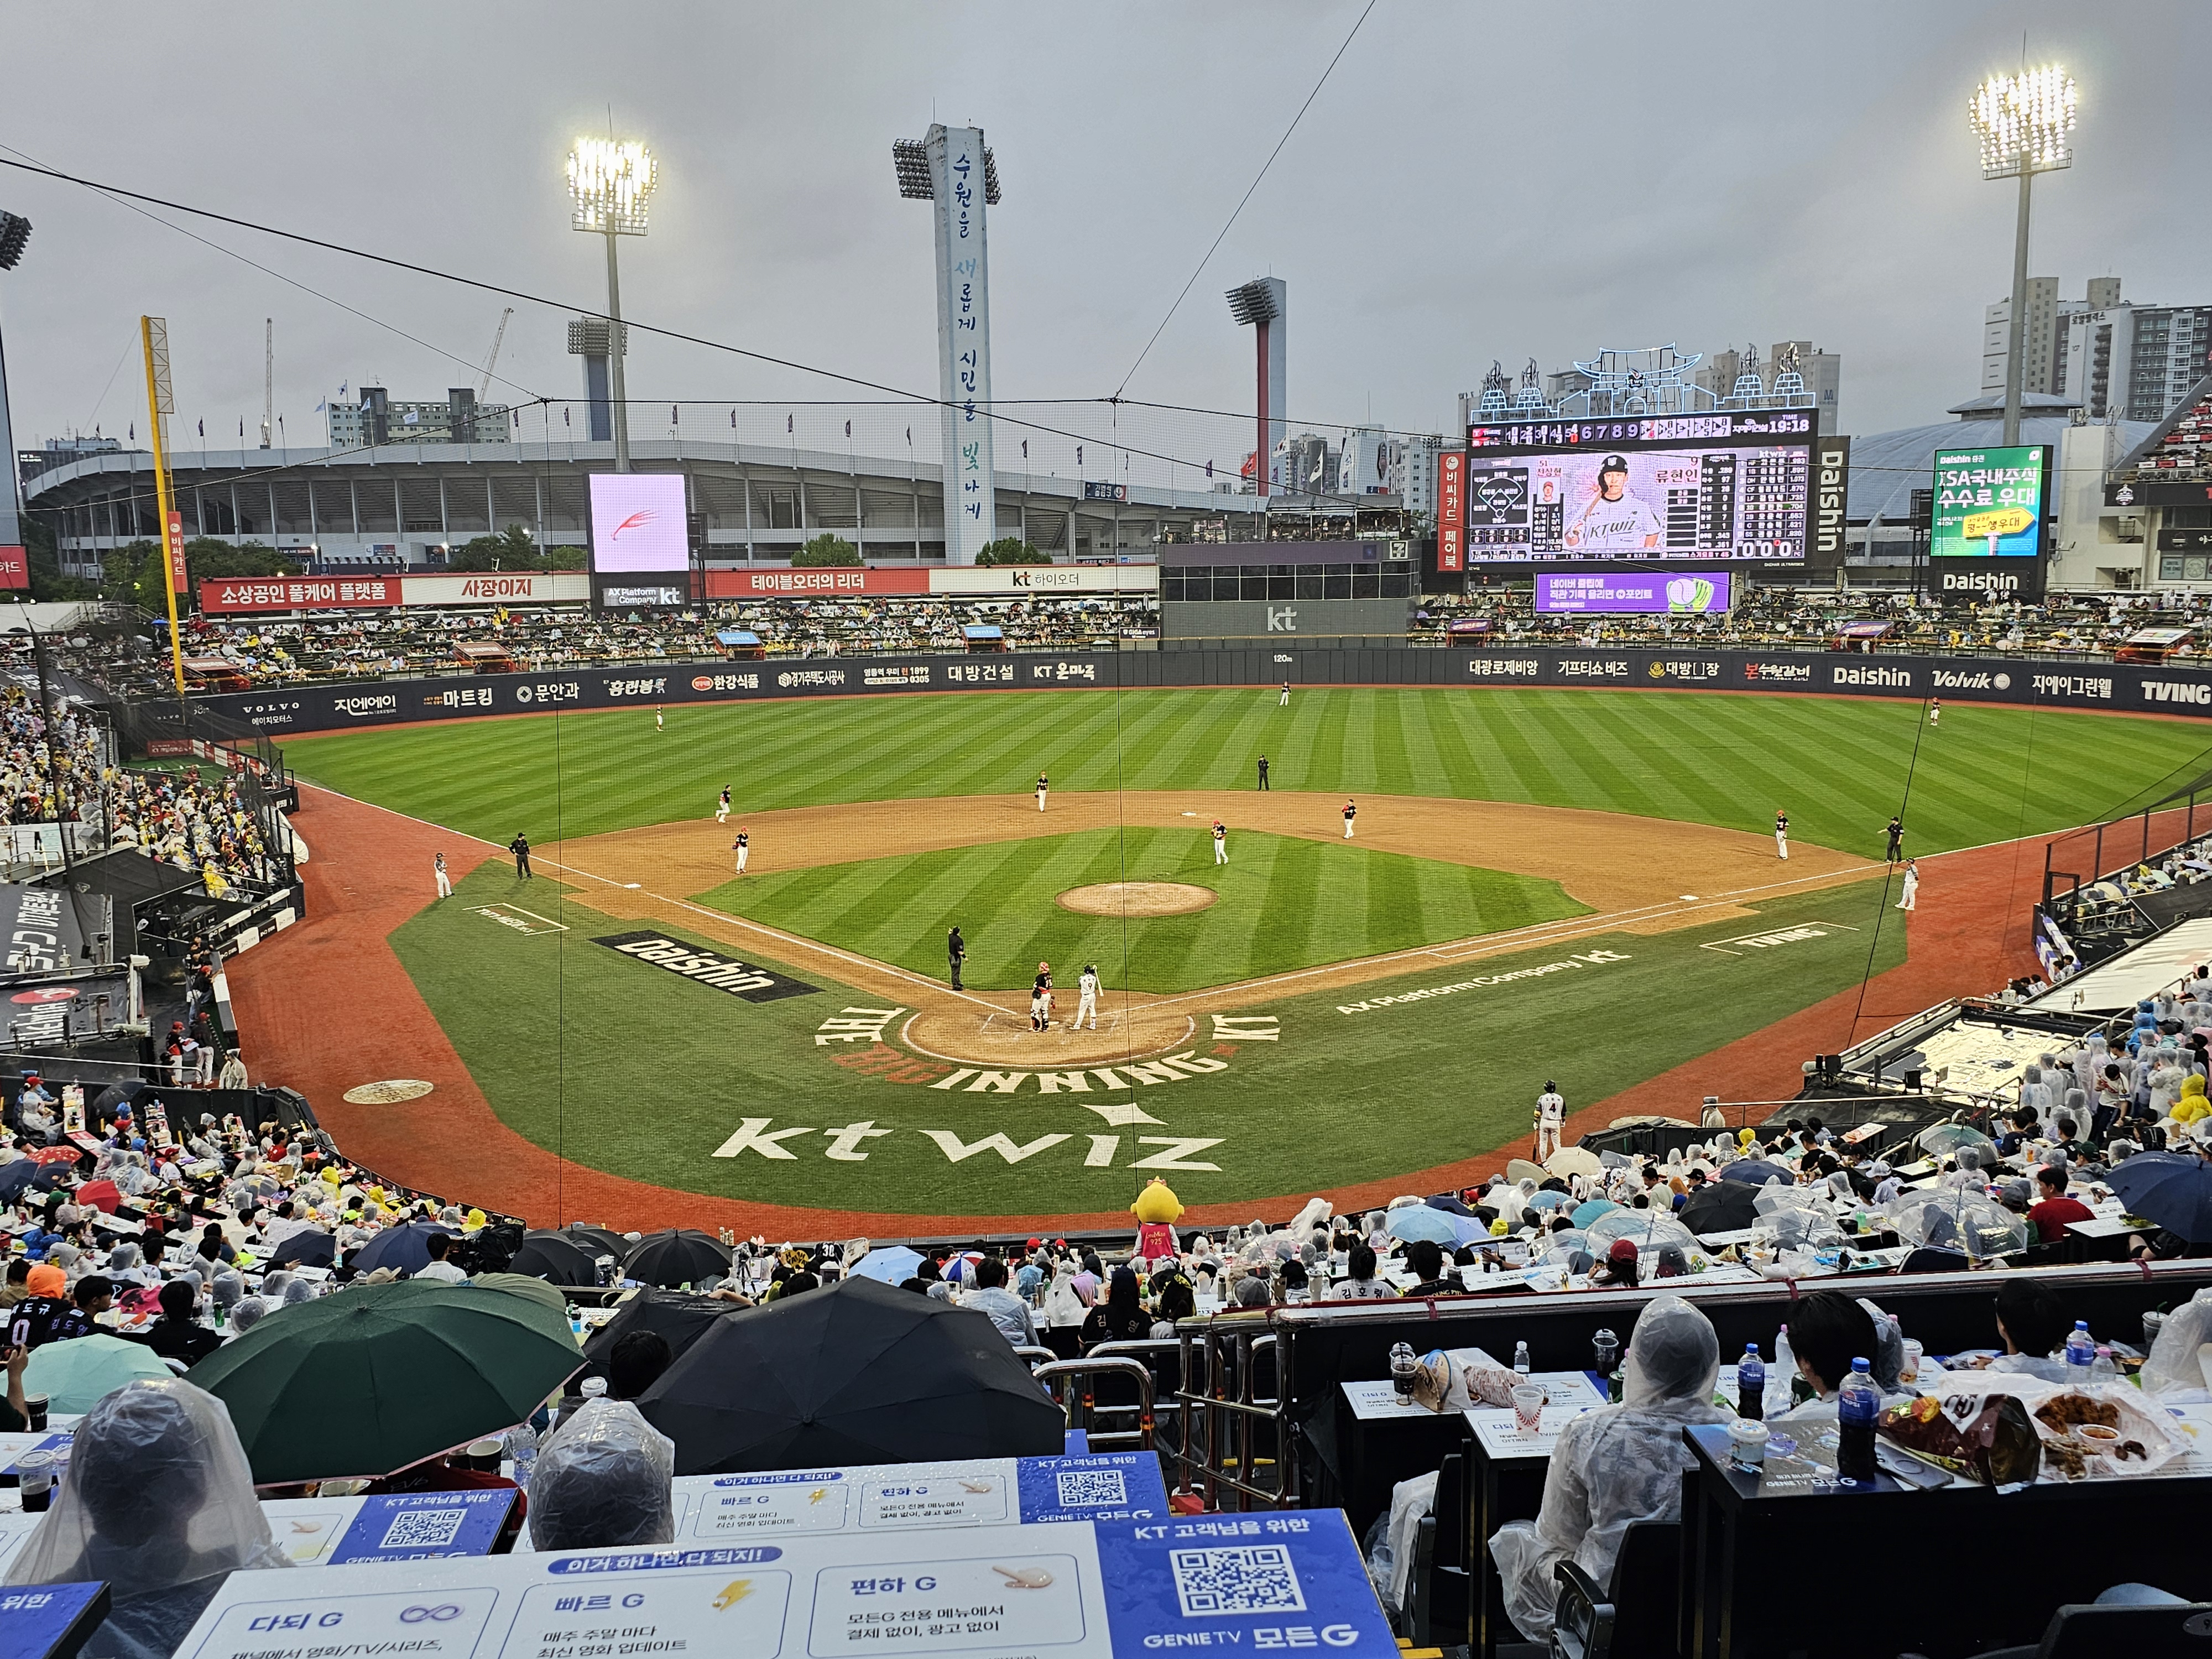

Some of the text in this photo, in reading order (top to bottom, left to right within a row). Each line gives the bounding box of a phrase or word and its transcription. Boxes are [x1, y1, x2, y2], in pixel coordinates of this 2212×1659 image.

[952, 153, 981, 520] 수원을 새롭게 시민을 빛나게
[1526, 424, 1578, 436] 2 1 4
[1611, 425, 1623, 438] 8
[1627, 424, 1639, 437] 9
[1704, 419, 1710, 427] 6
[1769, 419, 1810, 434] 19:18
[1542, 434, 1563, 444] 1 3
[1581, 426, 1593, 440] 6
[1597, 425, 1608, 439] 7
[1703, 429, 1709, 437] 5
[1691, 456, 1698, 466] 9
[1939, 455, 1985, 465] Daishin 증권
[1655, 469, 1698, 484] 류현인
[1817, 451, 1845, 551] Daishin
[1937, 487, 2036, 509] 수수료 우대
[1444, 471, 1458, 568] 비씨카드 페이북
[171, 536, 185, 577] 비씨카드
[1743, 541, 1792, 557] 0 0 0
[751, 573, 864, 591] 테이블오더의 리더
[1013, 571, 1079, 586] kt 하이오더
[1550, 578, 1604, 589] 네이버 클립에
[1943, 572, 2018, 590] Daishin
[221, 582, 386, 604] 소상공인 풀케어 플랫폼
[461, 578, 532, 598] 사장이지
[660, 587, 680, 605] kt
[1550, 589, 1614, 600] 직관 기록 올리면
[619, 596, 656, 605] Company
[1267, 606, 1297, 632] kt
[1273, 654, 1293, 662] 120m
[885, 667, 900, 676] 우미
[910, 666, 930, 675] 1899
[947, 664, 1014, 681] 대방건설
[1034, 665, 1053, 678] KT
[1469, 659, 1538, 676] 대광로제비앙
[713, 674, 759, 691] 한강식품
[790, 670, 845, 688] 경기주택도시공사
[909, 675, 930, 684] 0305
[1833, 666, 1911, 687] Daishin
[1932, 670, 1992, 690] Volvik
[535, 682, 580, 702] 문안과
[2031, 674, 2112, 700] 지에이그린웰
[2140, 680, 2211, 705] TVING
[443, 687, 493, 708] 마트킹
[242, 702, 301, 714] VOLVO
[251, 714, 293, 726] 에이치모터스
[1734, 928, 1828, 948] TVING
[614, 938, 775, 994] Daishin
[1087, 982, 1093, 990] 9
[1335, 949, 1633, 1015] AX Platform Company kt
[815, 1006, 1281, 1094] THE BIG INNING KT
[1548, 1103, 1557, 1114] 4
[711, 1102, 1227, 1171] kt wiz
[821, 1242, 836, 1255] 30
[1149, 1238, 1163, 1246] 925
[1341, 1288, 1384, 1301] 김호령
[12, 1319, 30, 1346] 0
[51, 1318, 89, 1337] 김도영
[1841, 1397, 1861, 1408] PEPSI
[1038, 1455, 1137, 1469] KT 고객님을 위한
[790, 1474, 802, 1483] 다
[386, 1493, 492, 1507] KT 고객님을 위한
[880, 1485, 928, 1498] 편하 G
[721, 1495, 770, 1506] 빠르 G
[1134, 1518, 1311, 1540] KT 고객님을 위한
[567, 1548, 762, 1572] 이거 하나면 다 되지!
[850, 1576, 937, 1595] 편하 G
[1, 1592, 53, 1610] 위한
[554, 1593, 645, 1613] 빠르 G
[248, 1612, 344, 1632] 다되 G
[847, 1604, 1004, 1625] 모든G 전용 메뉴에서
[543, 1625, 658, 1643] 매주 주말 마다
[847, 1620, 999, 1641] 결제 없이, 광고 없이
[1253, 1624, 1359, 1649] 모든G
[307, 1639, 443, 1657] 영화/TV/시리즈,
[536, 1639, 687, 1659] 최신 영화 업데이트
